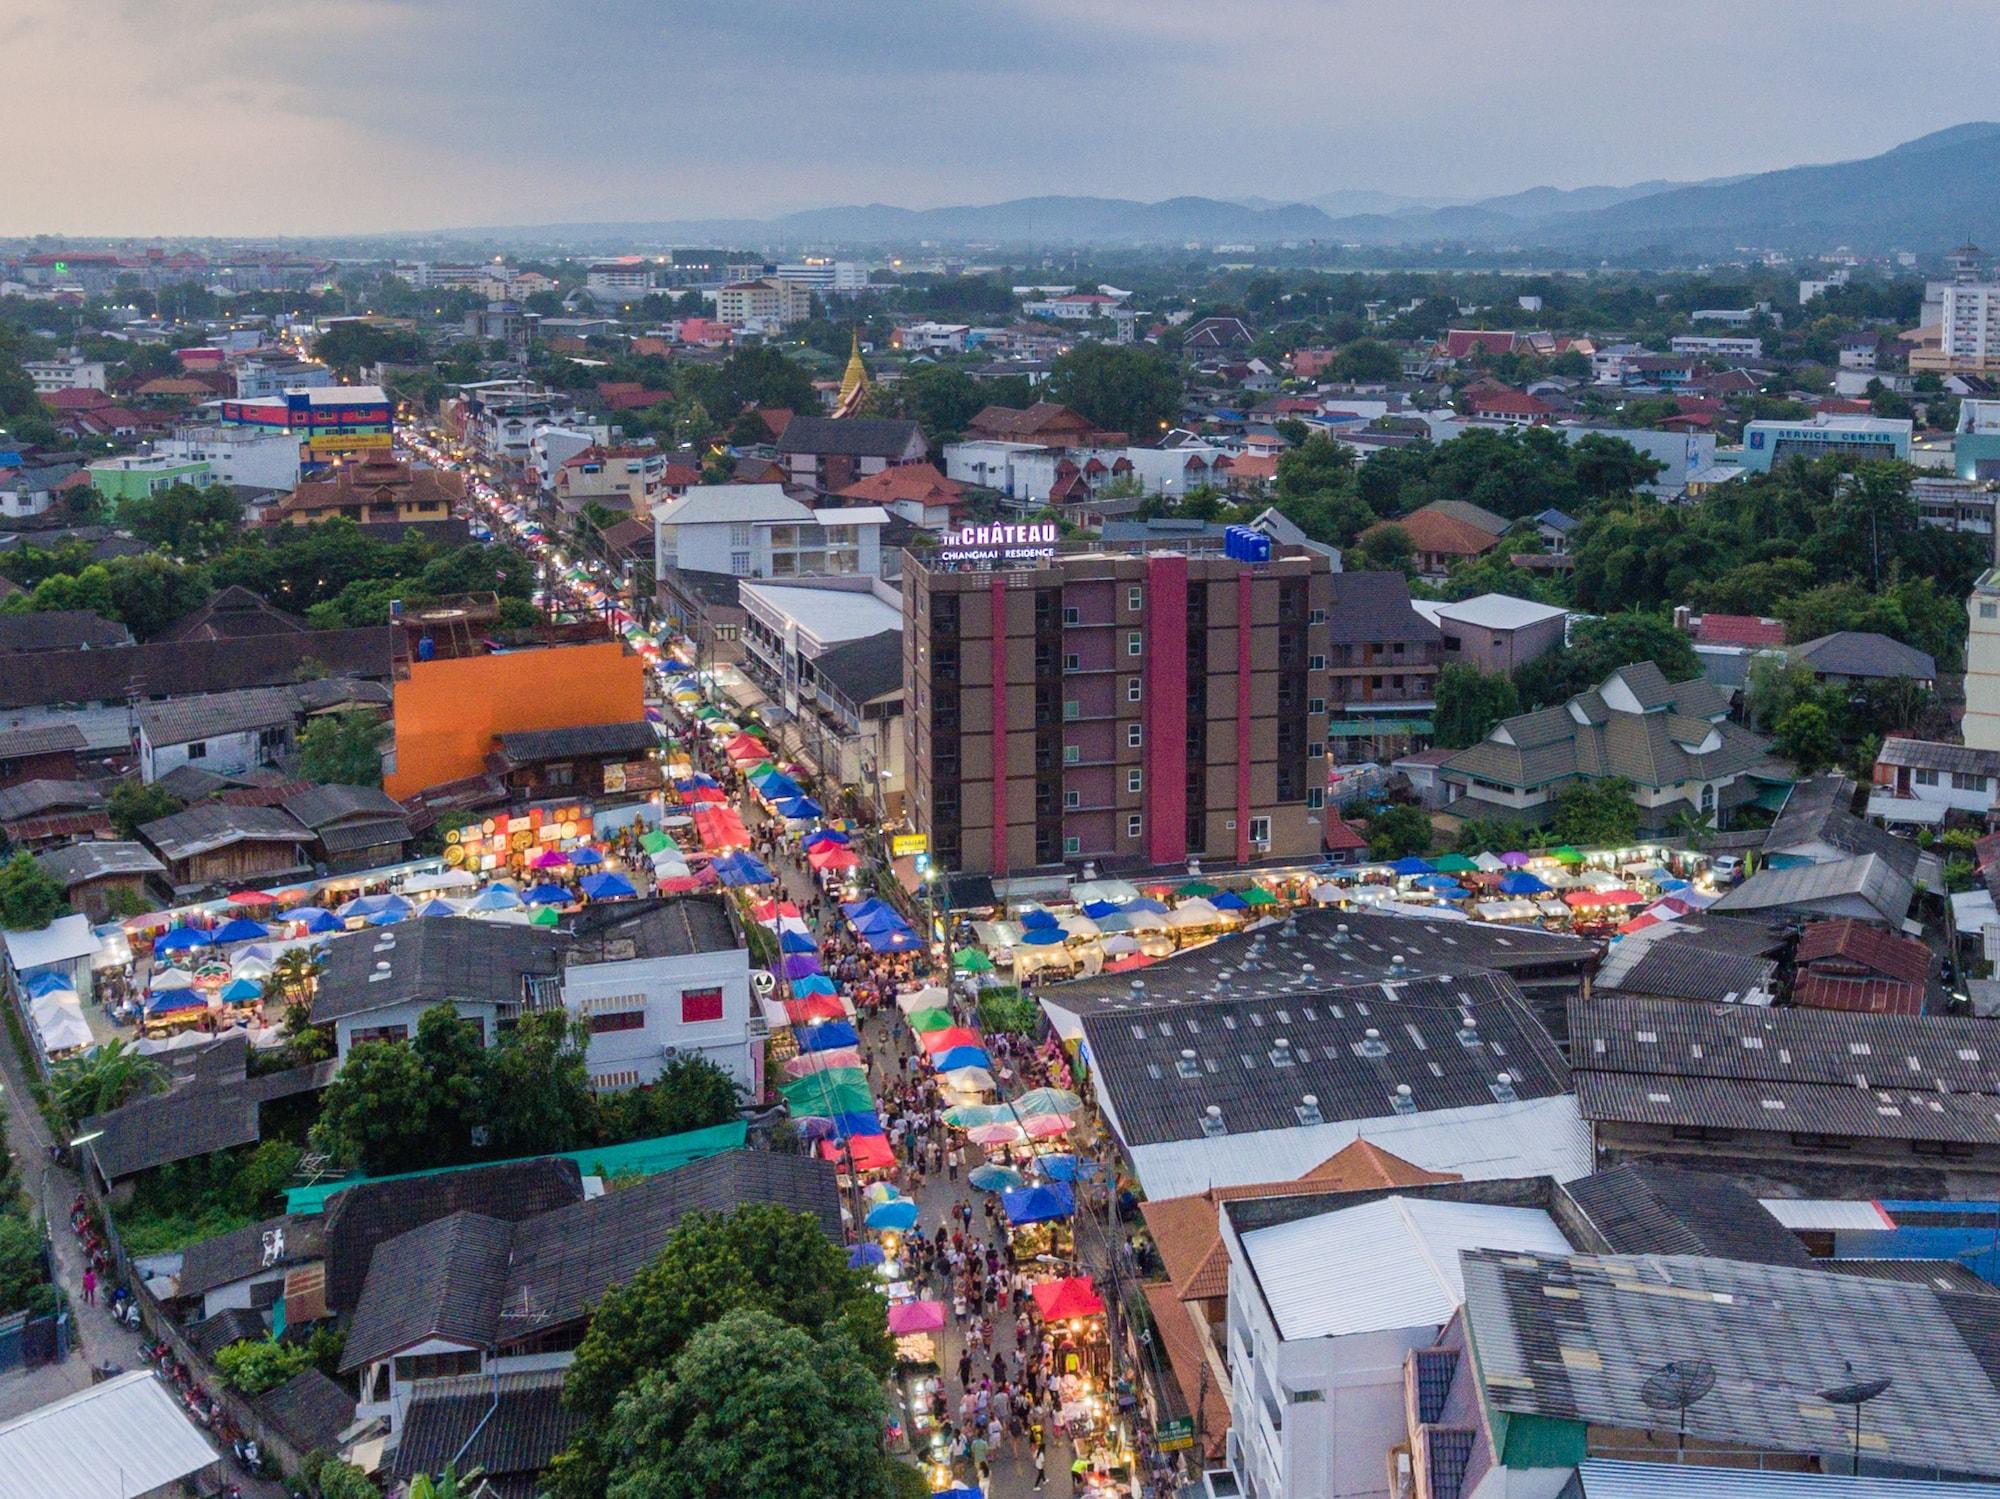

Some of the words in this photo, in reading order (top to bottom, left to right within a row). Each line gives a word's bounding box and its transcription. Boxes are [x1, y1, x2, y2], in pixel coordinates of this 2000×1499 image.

[1778, 430, 1829, 440] SERVICE
[1841, 433, 1891, 442] CENTER
[943, 536, 960, 545] THE
[961, 521, 1055, 545] CHÂTEAU
[942, 550, 998, 561] CHIANGMAI
[1005, 548, 1054, 558] RESIDENCE
